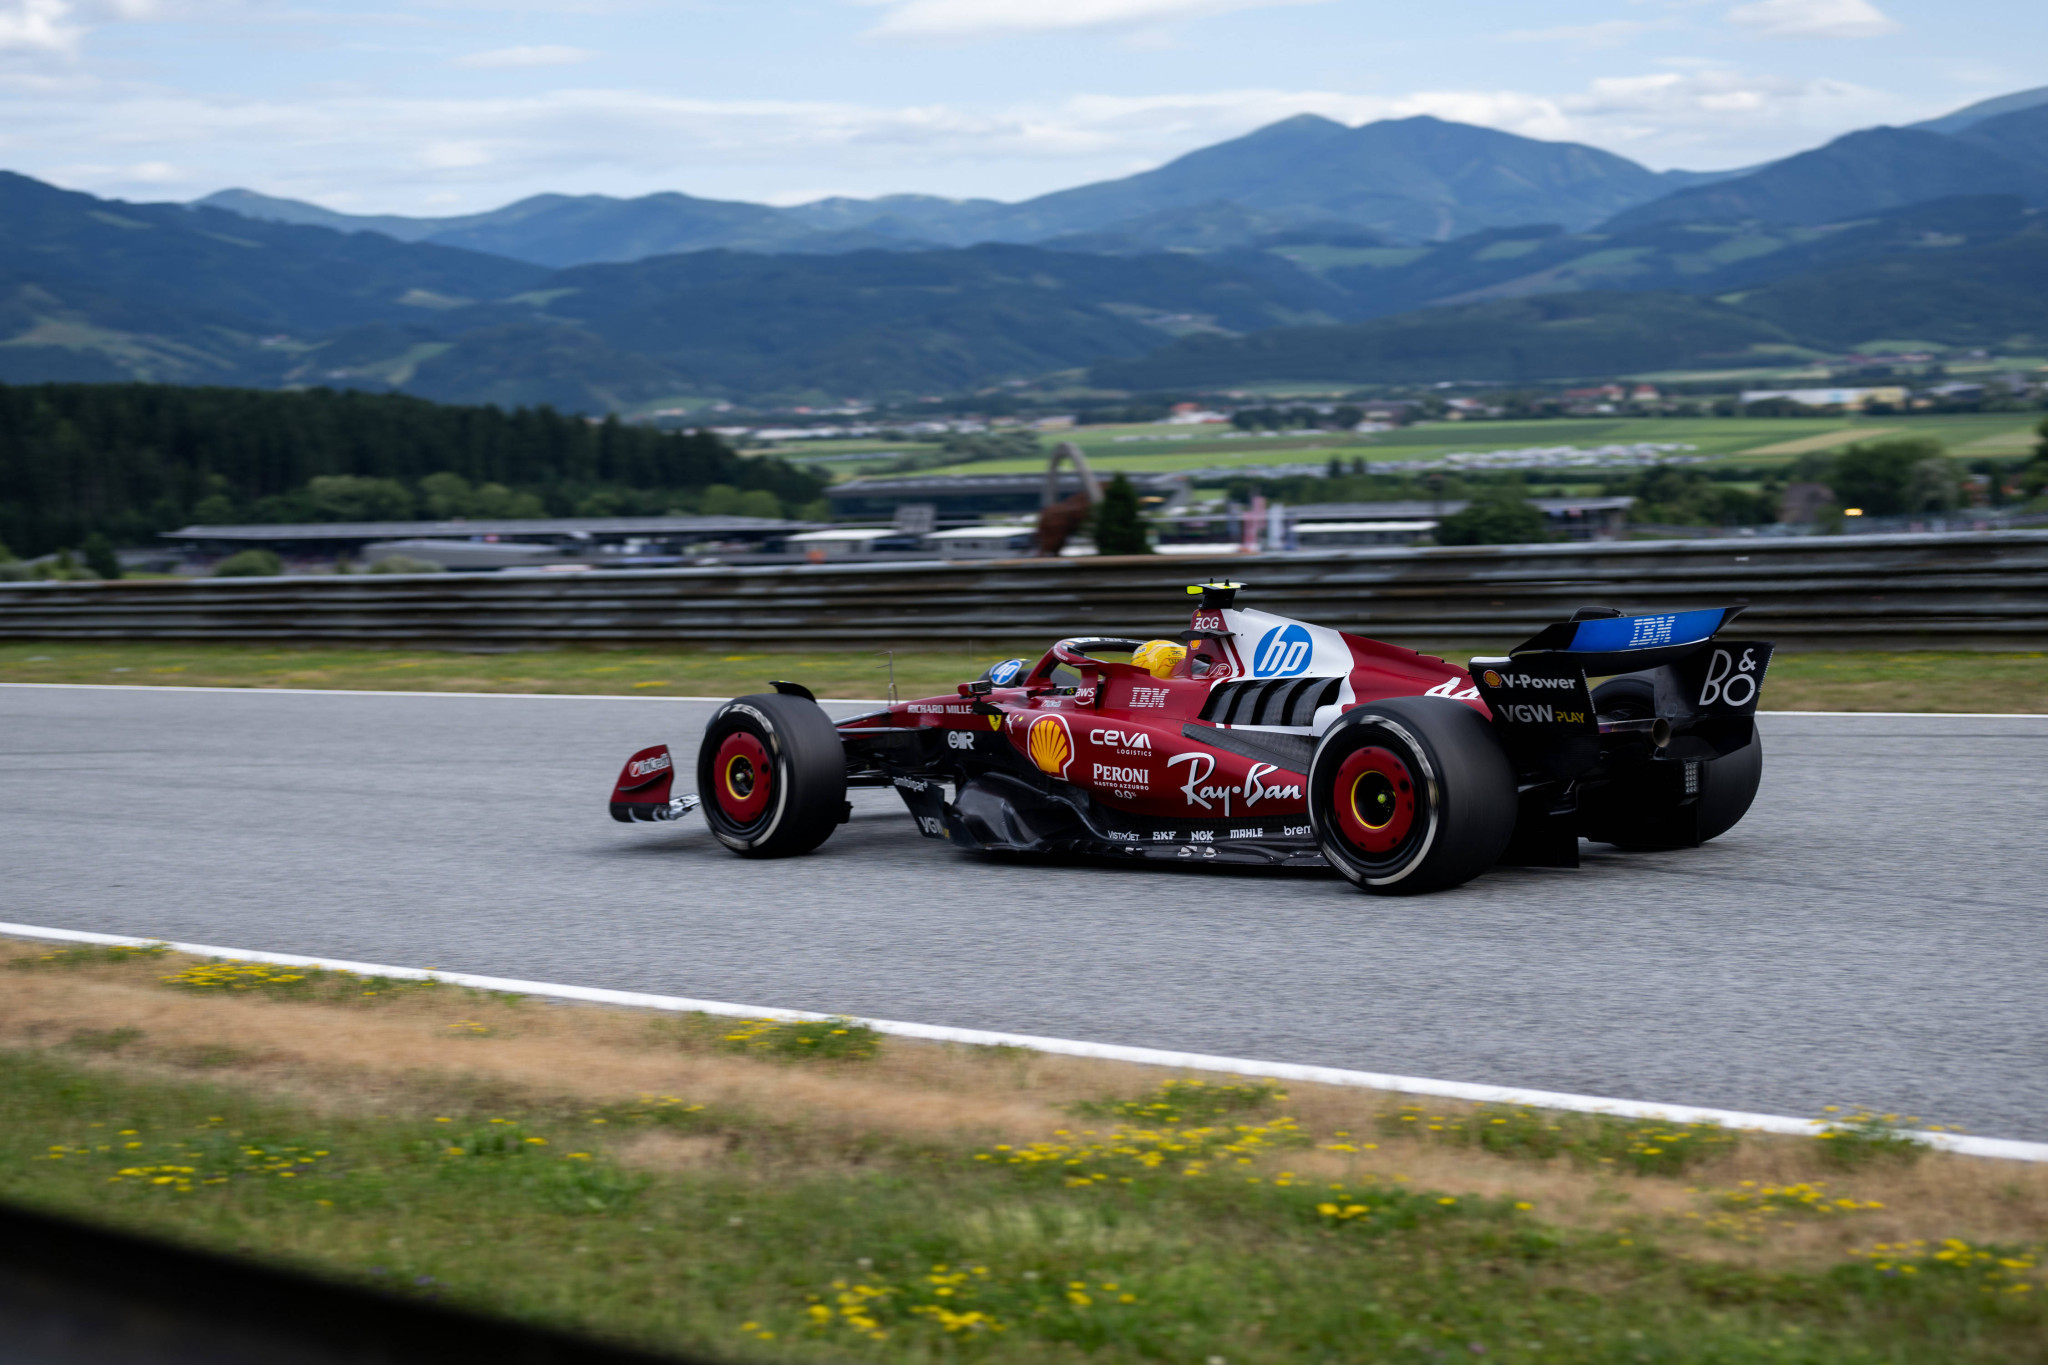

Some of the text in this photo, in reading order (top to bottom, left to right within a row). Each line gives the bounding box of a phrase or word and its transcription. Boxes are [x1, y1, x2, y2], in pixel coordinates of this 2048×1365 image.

[1628, 615, 1676, 647] IBM
[1255, 624, 1311, 677] hp
[993, 661, 1020, 685] hp
[1501, 674, 1576, 689] V-Power
[1074, 687, 1095, 698] aws
[1129, 687, 1170, 708] IBM
[907, 704, 973, 714] RICHARD MILLE
[1498, 704, 1584, 723] VGW PLAY
[1116, 748, 1152, 757] LOGISTICS
[1093, 763, 1149, 784] PERONI
[1093, 780, 1150, 791] NASTRO AZZURRO
[1152, 831, 1177, 841] SKF
[1190, 830, 1214, 841] NGK
[1230, 828, 1263, 839] MAHLE
